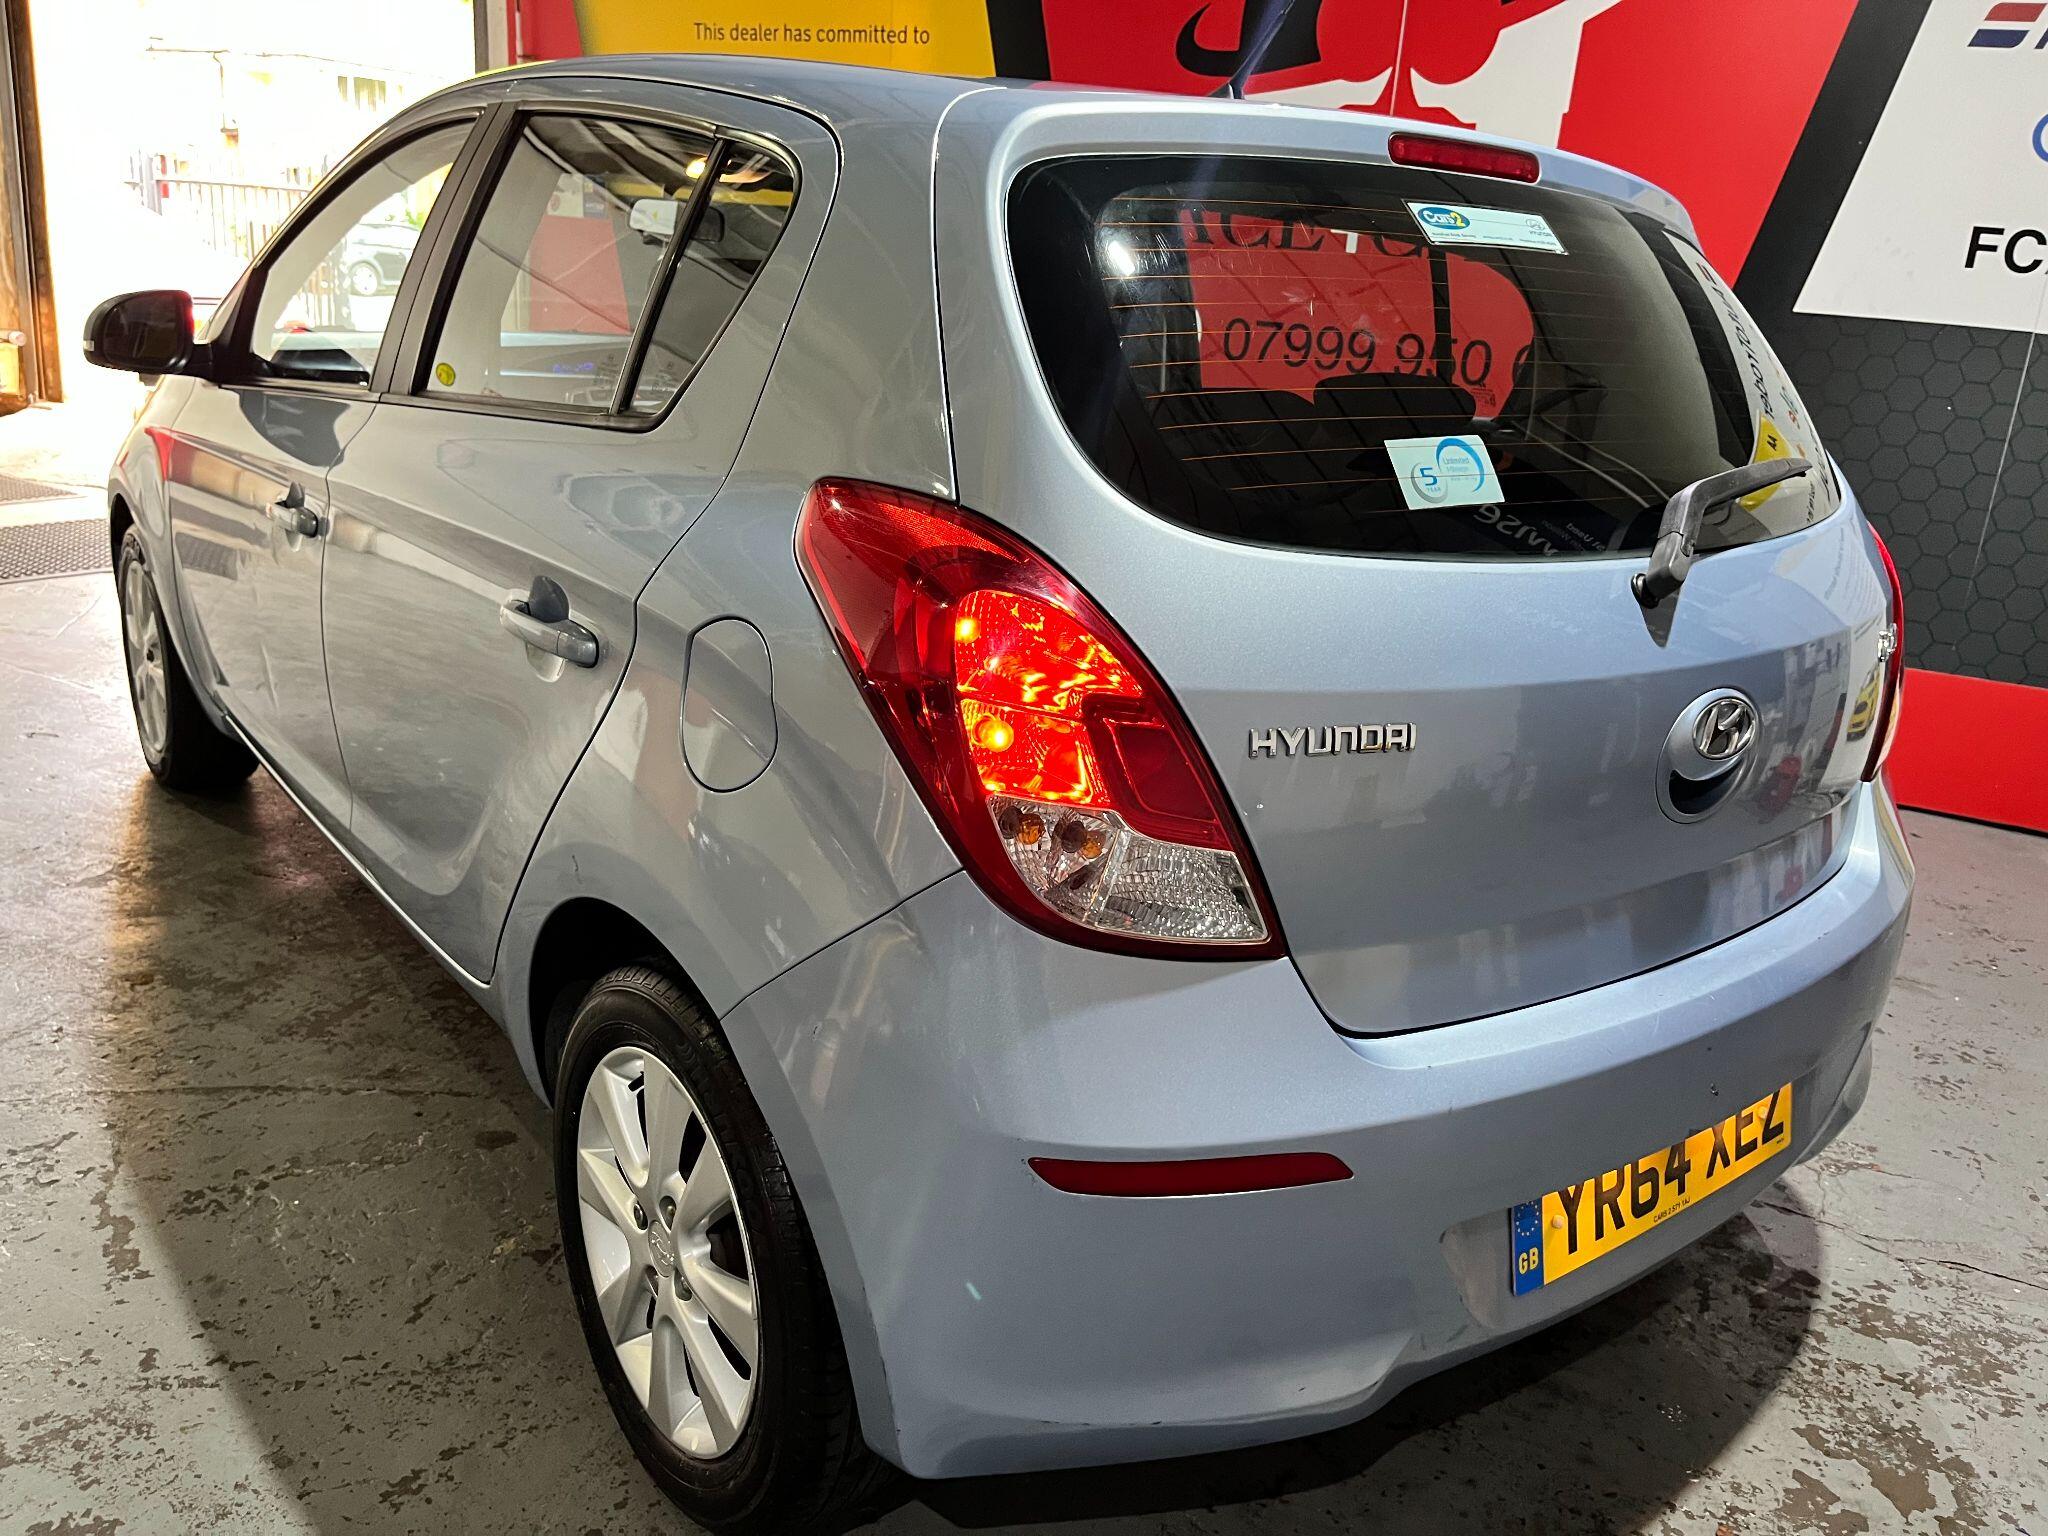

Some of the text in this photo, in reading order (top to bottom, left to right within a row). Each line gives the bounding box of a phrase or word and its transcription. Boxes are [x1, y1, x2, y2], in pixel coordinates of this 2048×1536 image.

[694, 22, 930, 45] This dealer has committed to
[1964, 226, 2048, 274] FC
[1223, 318, 1376, 374] 07999
[1419, 467, 1438, 486] 5
[1249, 722, 1417, 758] HYUNDAI
[1557, 1089, 1785, 1256] YR64 XEZ
[1518, 1247, 1539, 1275] GB
